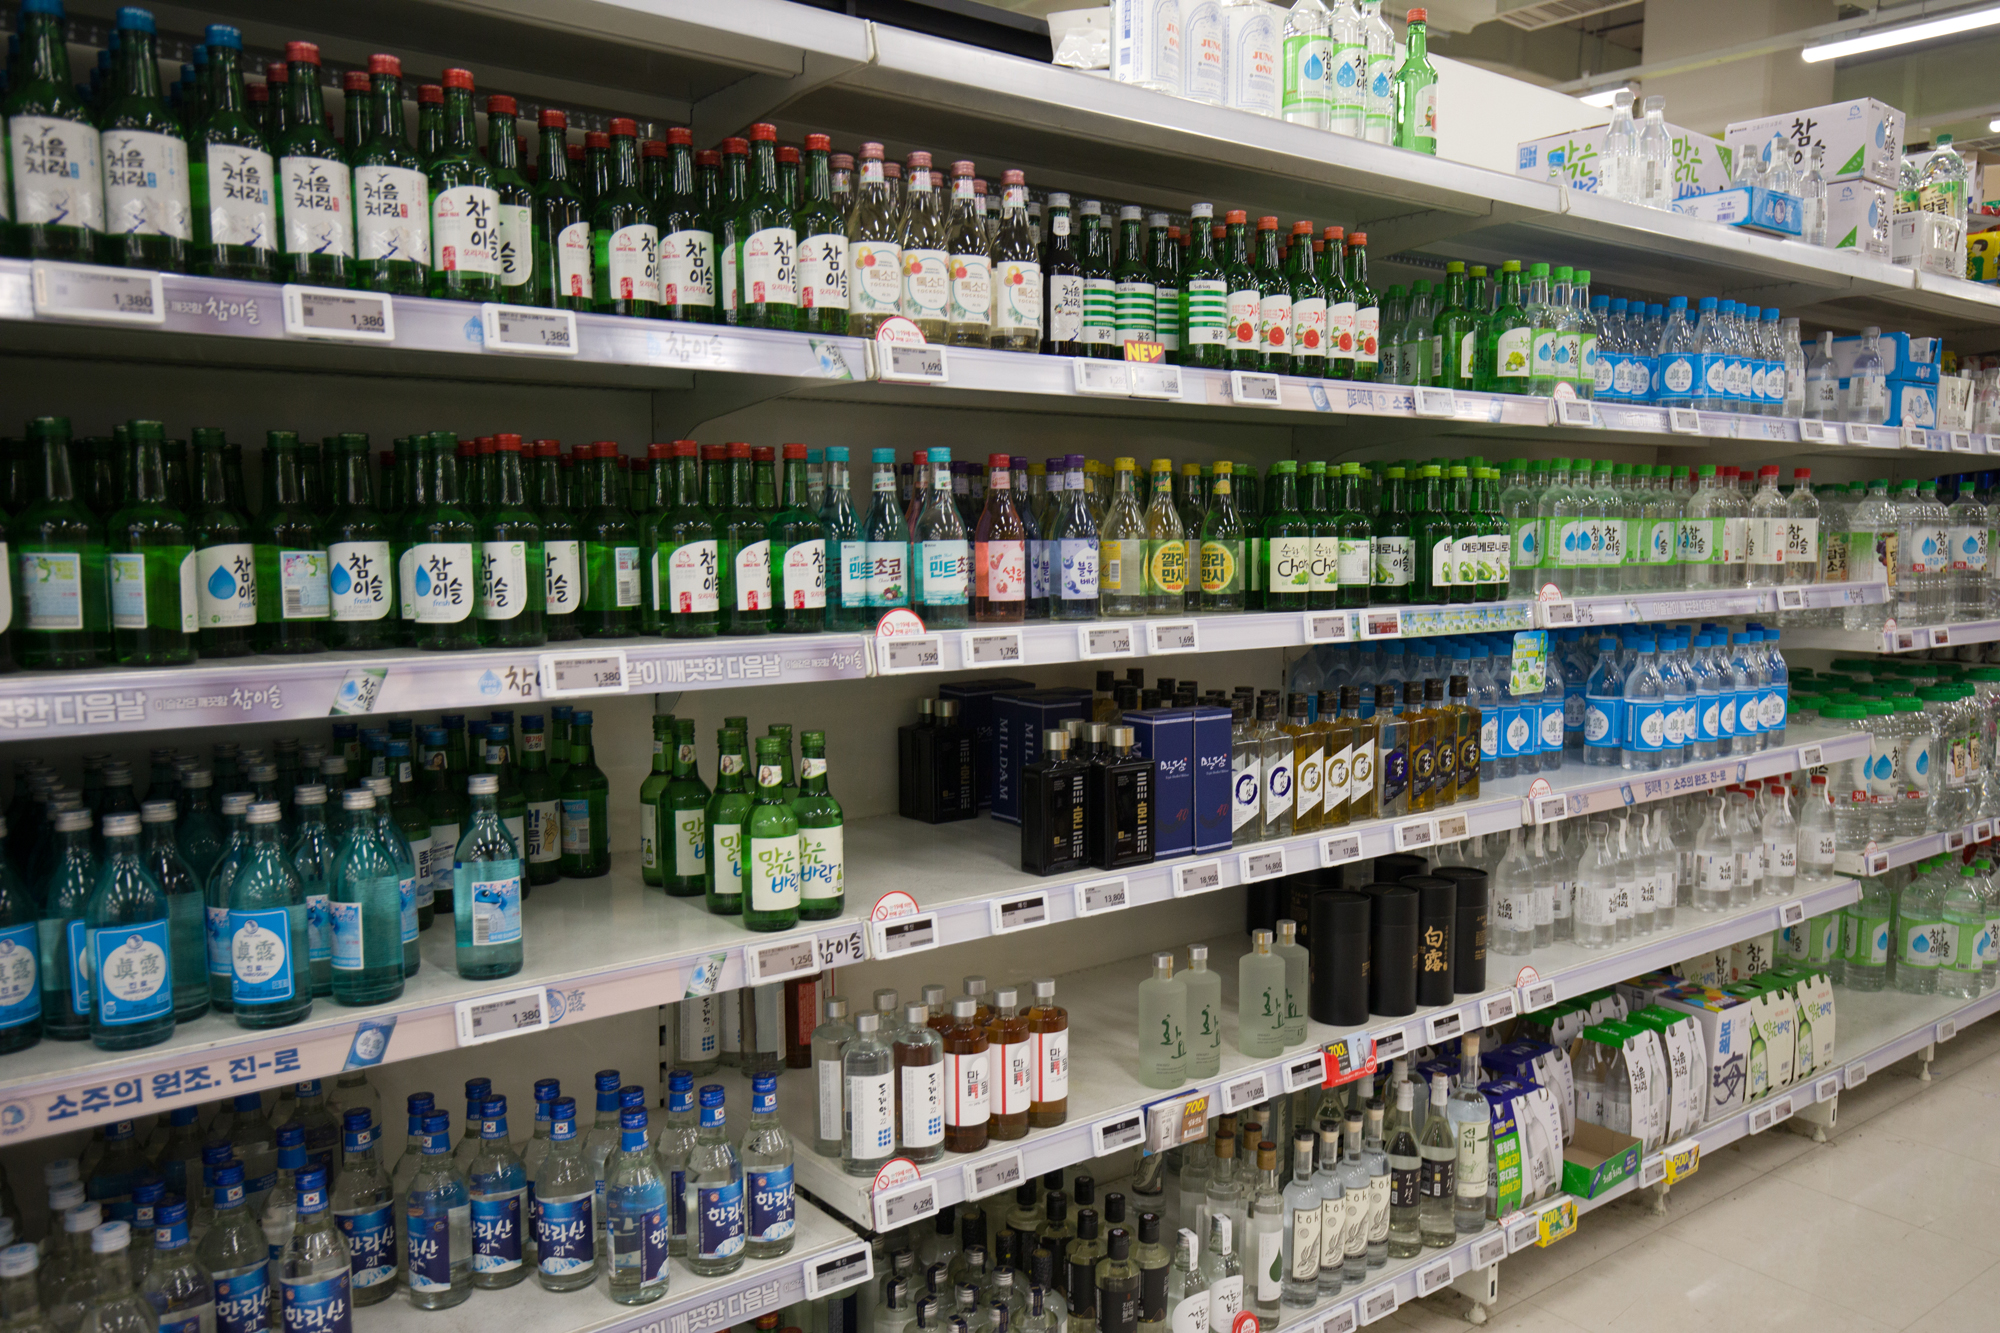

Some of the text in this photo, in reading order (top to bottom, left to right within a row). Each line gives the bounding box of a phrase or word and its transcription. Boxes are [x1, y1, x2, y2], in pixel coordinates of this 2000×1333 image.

[1791, 117, 1818, 147] 참
[24, 137, 67, 158] 처음
[26, 157, 69, 178] 처럼
[106, 150, 145, 171] 처음
[1672, 134, 1703, 183] 맑은
[108, 169, 147, 188] 처럼
[221, 163, 260, 185] 처음
[293, 174, 331, 194] 처음
[223, 184, 262, 204] 처럼
[364, 182, 400, 201] 처음
[296, 193, 333, 211] 처럼
[366, 201, 400, 217] 처럼
[466, 195, 491, 228] 참
[471, 228, 499, 261] 이슬
[686, 238, 706, 268] 참
[774, 236, 793, 265] 참
[822, 243, 842, 271] 참
[690, 266, 714, 295] 이슬
[112, 292, 152, 307] 1,380
[205, 295, 260, 326] 참이슬
[351, 314, 385, 327] 1,380
[540, 330, 570, 343] 1,380
[665, 331, 726, 365] 참이슬
[1126, 346, 1163, 362] NEW
[920, 360, 943, 373] 1,690
[1605, 525, 1617, 543] 참
[1788, 523, 1803, 540] 참
[1789, 538, 1808, 555] 이슬
[234, 555, 251, 582] 참
[350, 552, 373, 579] 참
[430, 555, 453, 581] 참
[699, 548, 716, 575] 참
[850, 557, 901, 581] 민트 초코
[930, 559, 957, 579] 민트
[1162, 553, 1184, 568] 깔라
[1202, 553, 1226, 567] 깔라
[1162, 568, 1184, 583] 만시
[1202, 568, 1225, 583] 만시
[354, 574, 384, 602] 이슬
[434, 577, 463, 605] 이슬
[1112, 639, 1130, 648] 1,790
[1178, 635, 1195, 644] 1,690
[918, 652, 938, 663] 1,590
[999, 646, 1019, 657] 1,790
[593, 671, 621, 683] 1,380
[667, 653, 724, 684] 깨끗한
[727, 651, 781, 679] 다음날
[831, 650, 863, 671] 참이슬
[54, 685, 285, 724] 다음날 참이슬
[999, 717, 1009, 801] MILDAM
[1176, 808, 1190, 822] 40
[1216, 803, 1230, 817] 40
[758, 847, 795, 878] 맑은
[1264, 862, 1283, 872] 16,800
[771, 872, 799, 894] 바람
[800, 863, 837, 884] 바람
[1199, 874, 1219, 885] 18,900
[1104, 892, 1125, 903] 13,800
[1424, 925, 1444, 973] 白露
[1747, 943, 1764, 962] 참
[790, 953, 813, 967] 1,250
[512, 1008, 541, 1024] 1,380
[1718, 1019, 1732, 1054] 보해
[47, 1047, 301, 1122] 소주의 원조. 진-로
[1463, 1126, 1476, 1155] 선비
[996, 1167, 1020, 1182] 11,490
[913, 1198, 934, 1211] 6,290
[537, 1219, 586, 1243] 한라산
[553, 1245, 565, 1257] 21
[285, 1299, 346, 1331] 한라산
[670, 1280, 780, 1333] 깨끗한 다음날
